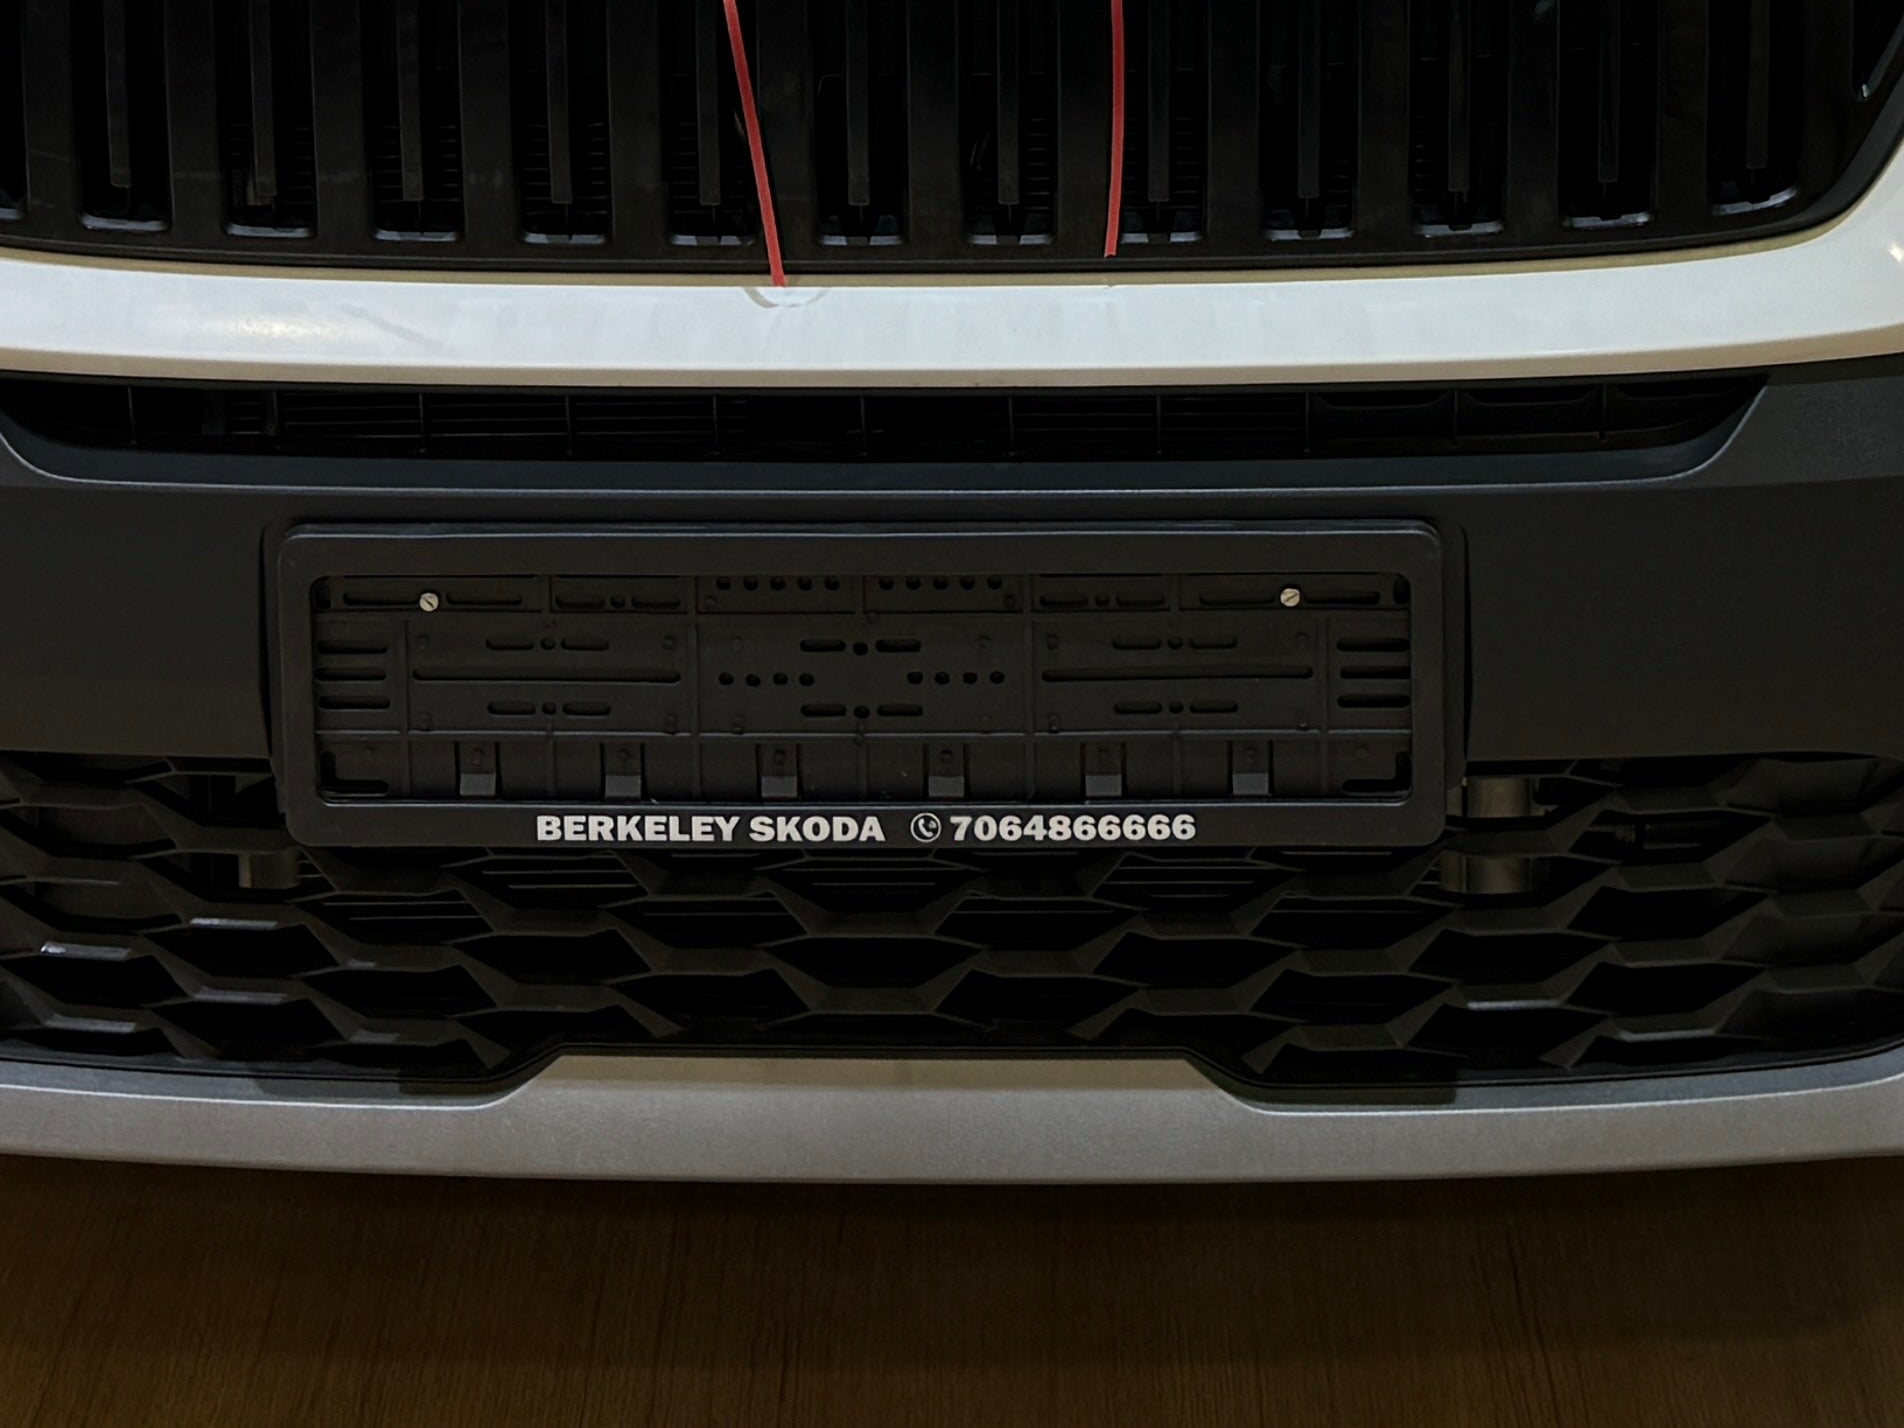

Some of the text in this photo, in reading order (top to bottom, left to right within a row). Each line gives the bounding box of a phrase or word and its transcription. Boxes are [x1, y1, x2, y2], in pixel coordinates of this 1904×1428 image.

[536, 814, 1197, 842] BERKELEY SKODA 7064866666
